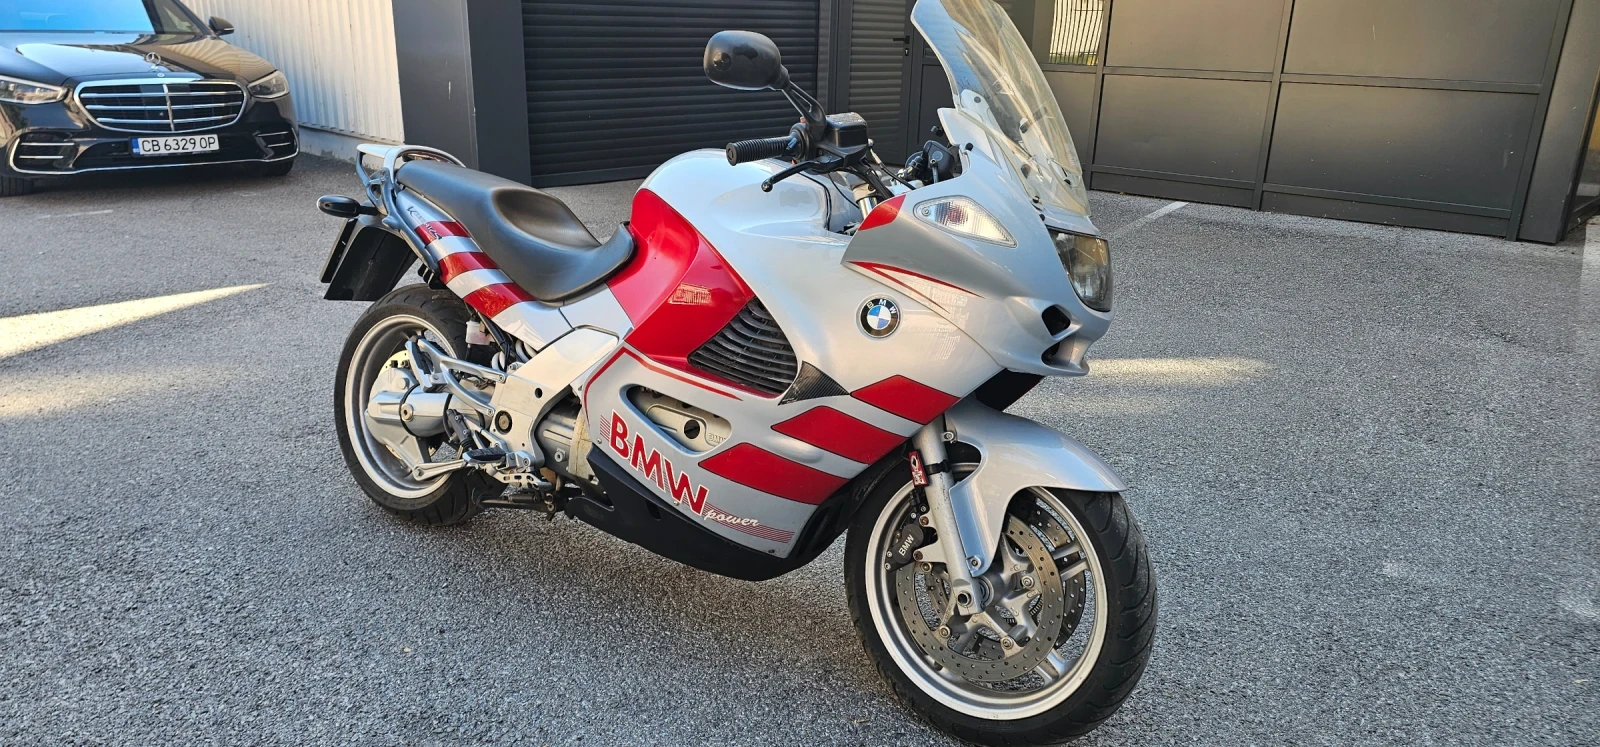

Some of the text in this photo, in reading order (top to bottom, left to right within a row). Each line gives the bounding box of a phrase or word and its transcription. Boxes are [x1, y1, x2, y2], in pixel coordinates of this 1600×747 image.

[142, 140, 160, 152] CB
[164, 138, 196, 151] 6329
[200, 137, 215, 149] OP
[866, 298, 897, 314] BMW
[609, 409, 760, 527] BMW power
[898, 534, 915, 557] BMW
